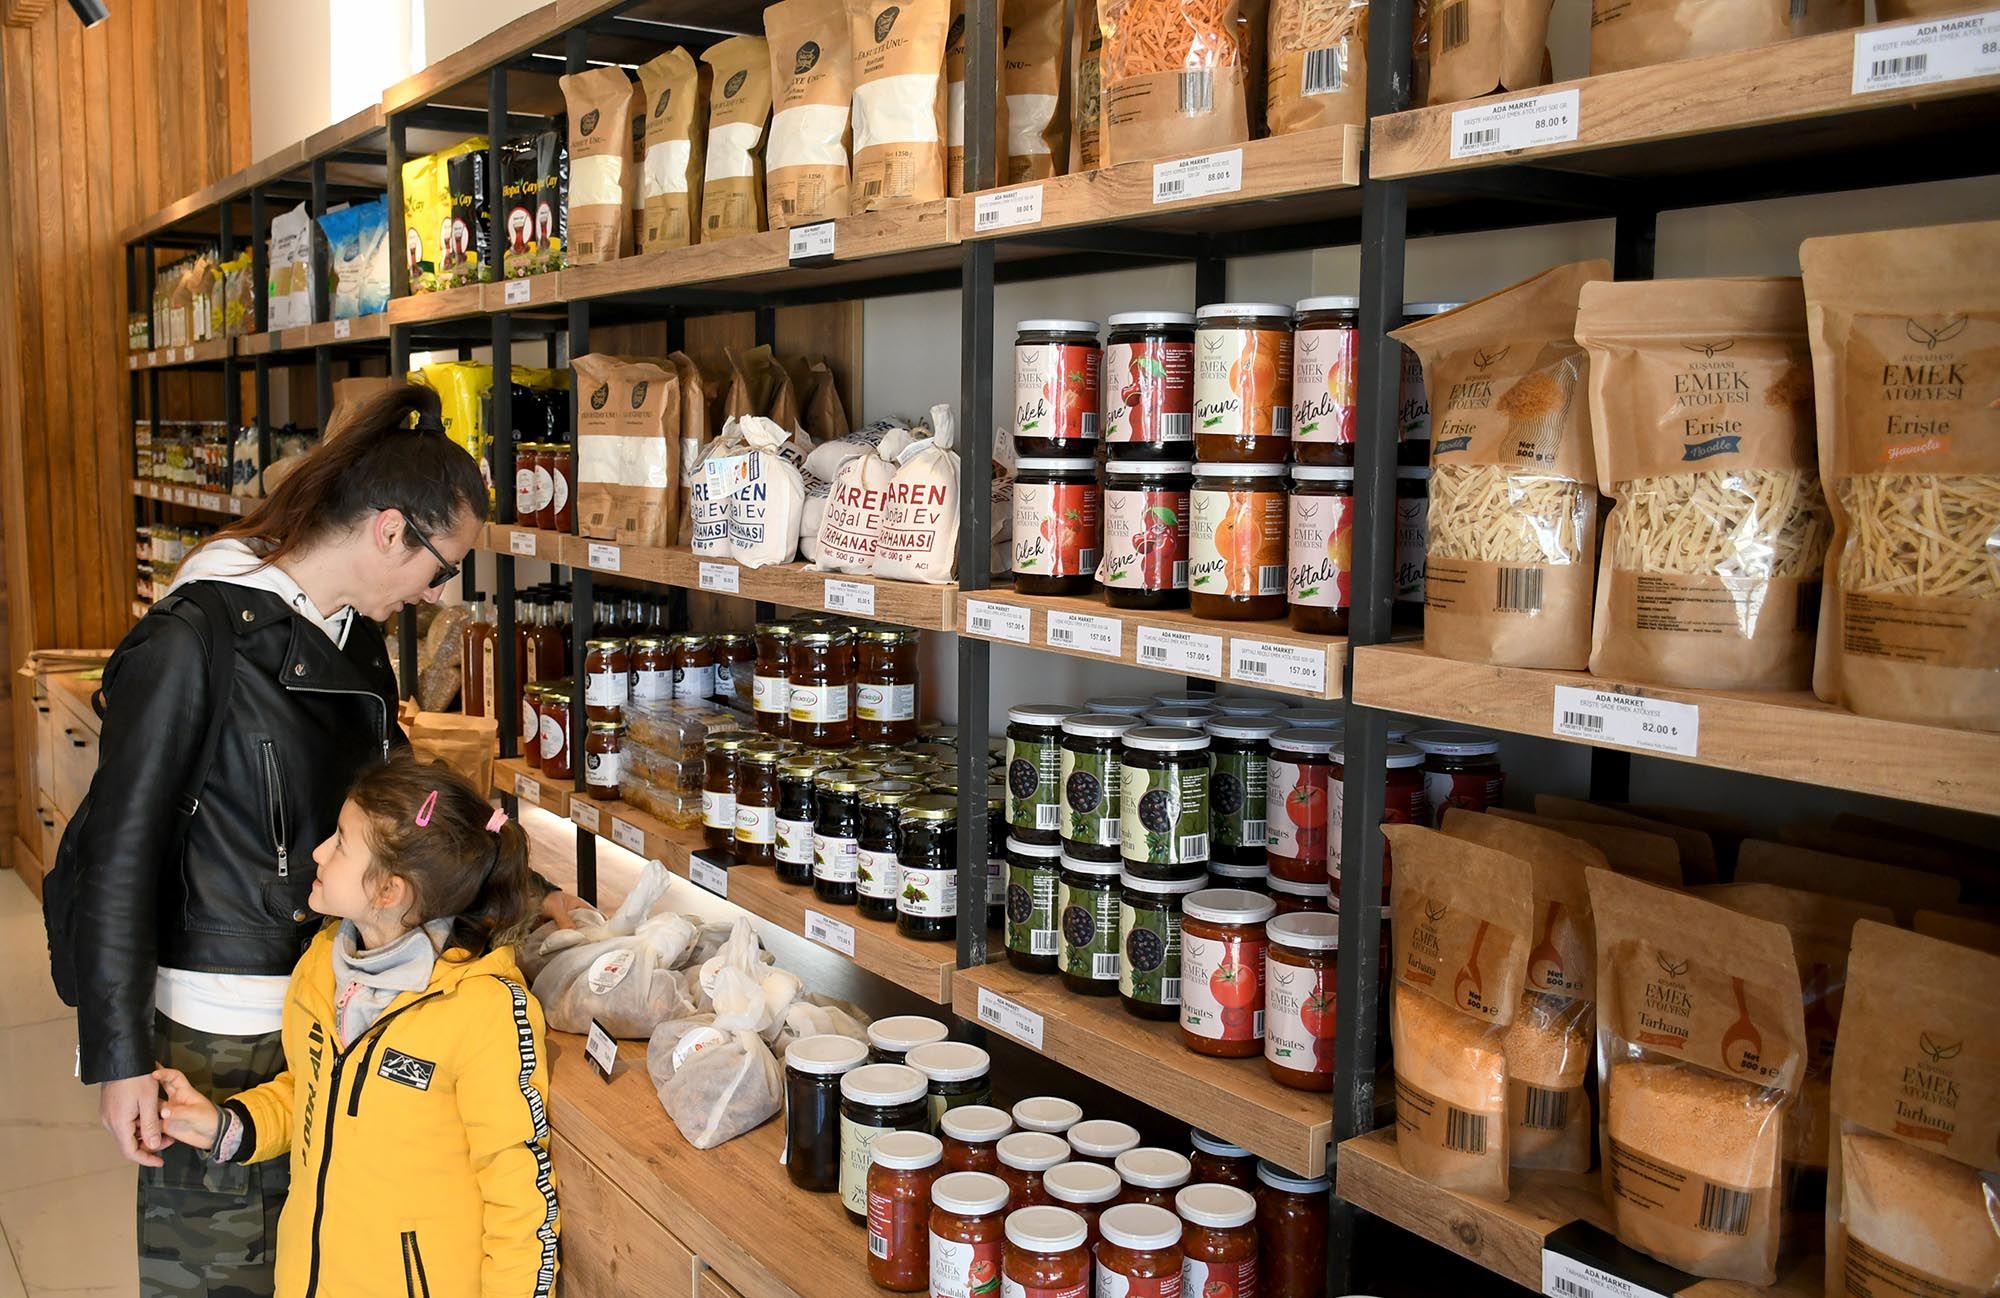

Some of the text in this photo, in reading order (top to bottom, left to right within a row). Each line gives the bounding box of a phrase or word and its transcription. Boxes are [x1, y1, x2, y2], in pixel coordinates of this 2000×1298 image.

[1917, 18, 1984, 36] ADA MARKET
[1492, 100, 1537, 114] ADA MARKET
[1535, 117, 1559, 129] 88.00
[1179, 157, 1209, 168] ADA MARKET
[522, 179, 538, 195] Çay
[1673, 370, 1750, 394] EMEK
[1882, 363, 1968, 386] EMEK
[1449, 381, 1494, 400] EMEK
[1441, 419, 1477, 438] Erişte
[1685, 416, 1742, 437] Erişte
[1886, 415, 1950, 438] Erişte
[1518, 440, 1535, 450] Net
[1515, 450, 1534, 459] 500
[888, 482, 947, 506] AREN
[746, 504, 766, 519] Ev
[827, 503, 884, 530] Doğal E
[913, 508, 941, 525] Ev
[823, 527, 878, 553] TARHANAS
[1294, 529, 1323, 541] EMEK
[836, 552, 848, 561] 500
[1289, 557, 1335, 595] Şeftali
[1172, 633, 1191, 641] MARKET
[1185, 650, 1205, 661] 157.00
[1261, 644, 1294, 655] ADA MARKET
[1289, 665, 1311, 676] 157.00
[1596, 694, 1645, 707] ADA MARKET
[1616, 705, 1631, 713] EMEK
[1642, 722, 1669, 735] 82.00
[1412, 927, 1441, 952] EMEK
[1407, 951, 1437, 977] Tarhana
[1547, 969, 1563, 979] Net
[1546, 977, 1563, 987] 500
[1270, 990, 1300, 1009] EMEK
[1468, 989, 1482, 1001] Net
[1645, 983, 1694, 1009] EMEK
[1467, 998, 1481, 1010] 500
[1638, 1011, 1689, 1039] Tarhana
[1267, 1028, 1305, 1051] Domates
[1743, 1051, 1760, 1062] Net
[1741, 1060, 1758, 1071] 500
[1903, 1065, 1961, 1099] EMEK
[1895, 1099, 1955, 1133] Tarhana
[935, 1262, 960, 1275] EMEK
[1584, 1268, 1632, 1292] ADA MARKET
